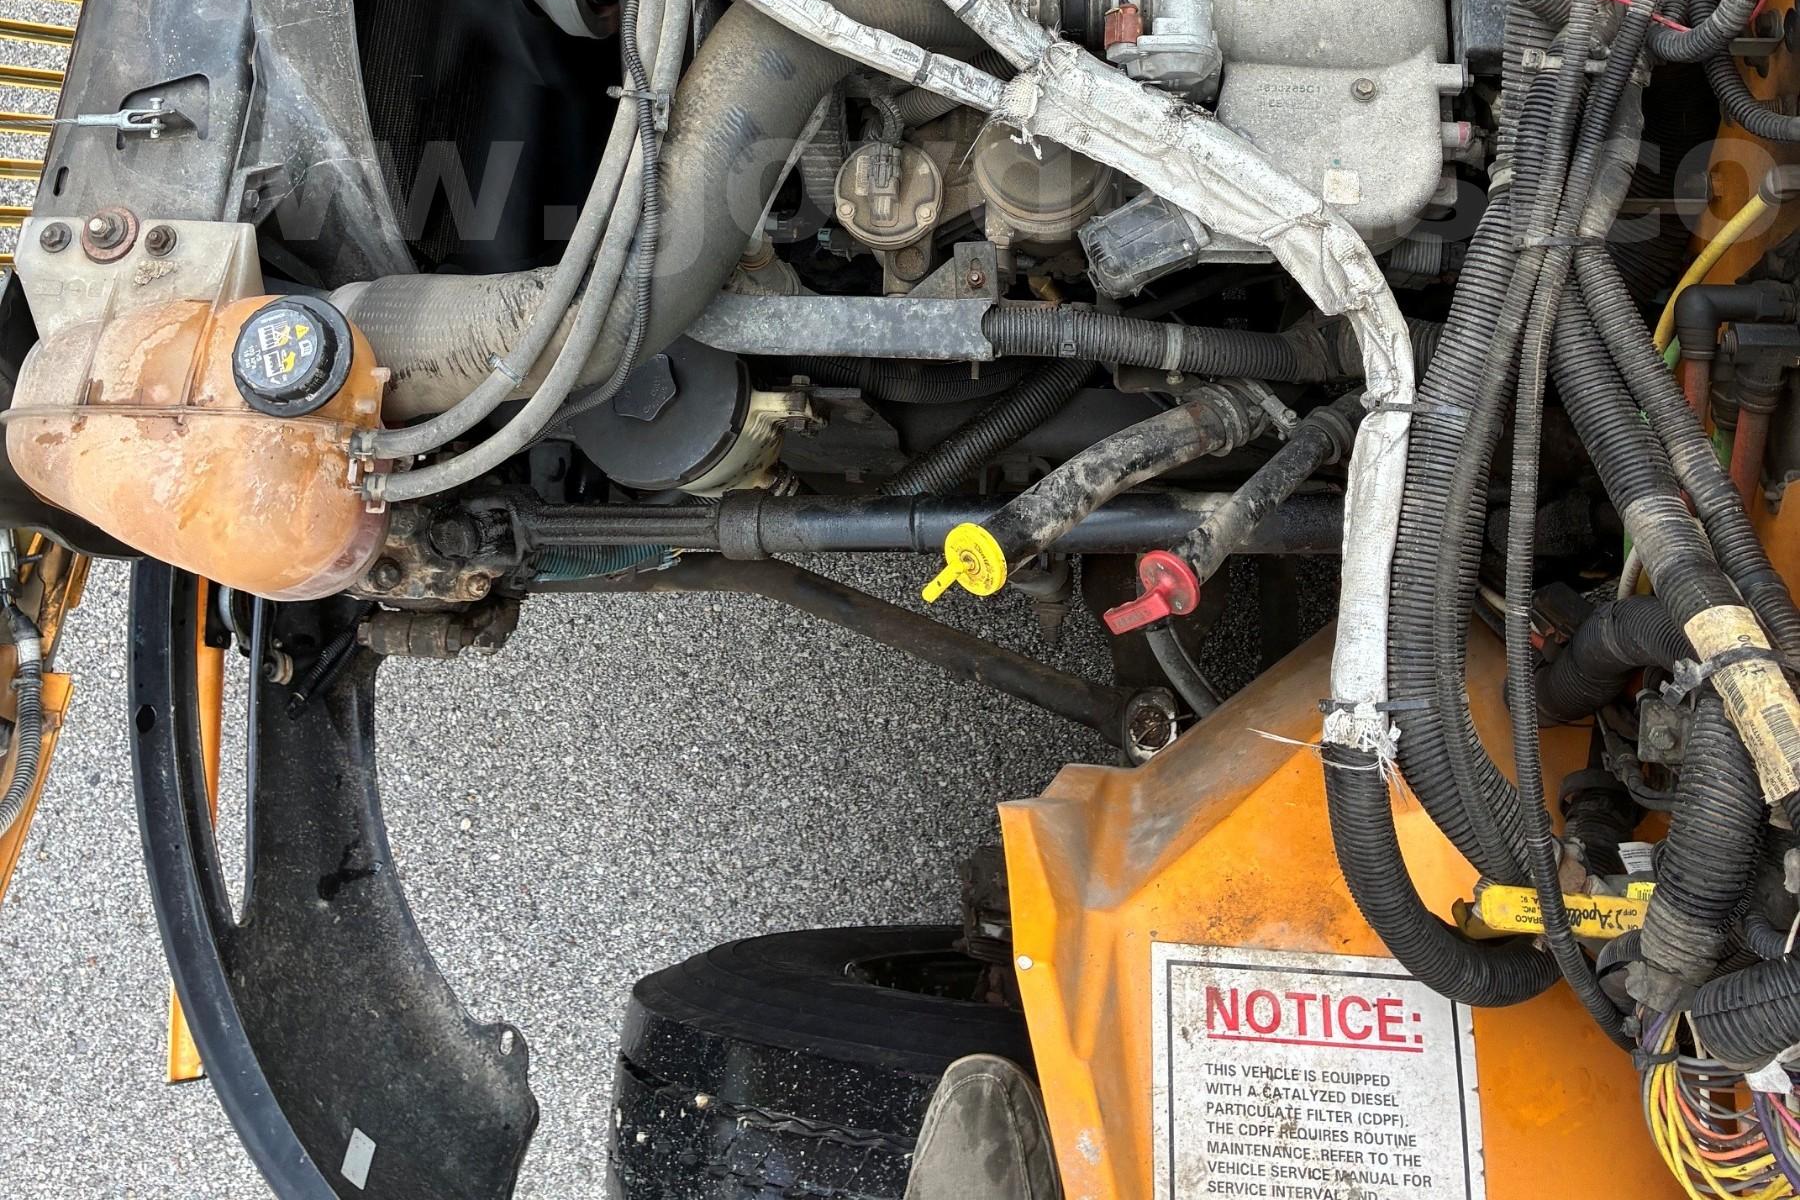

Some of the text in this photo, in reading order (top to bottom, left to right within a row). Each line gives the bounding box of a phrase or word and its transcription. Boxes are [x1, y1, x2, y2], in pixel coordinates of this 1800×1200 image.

[1204, 985, 1424, 1045] NOTICE:
[1205, 1062, 1391, 1087] THIS VEHICLE IS EQUIPPED
[1205, 1082, 1399, 1107] WITH A CATALYZED DIESEL
[1206, 1101, 1409, 1129] PARTICULATE FILTER (CDPF).
[1207, 1121, 1417, 1148] THE CDPF REQUIRES ROUTINE
[1207, 1140, 1422, 1167] MAINTENANCE. REFER TO THE
[1207, 1161, 1432, 1187] VEHICLE SERVICE MANUAL FOR
[1207, 1180, 1267, 1196] SERVICE
[1271, 1185, 1339, 1200] INTERVAL
